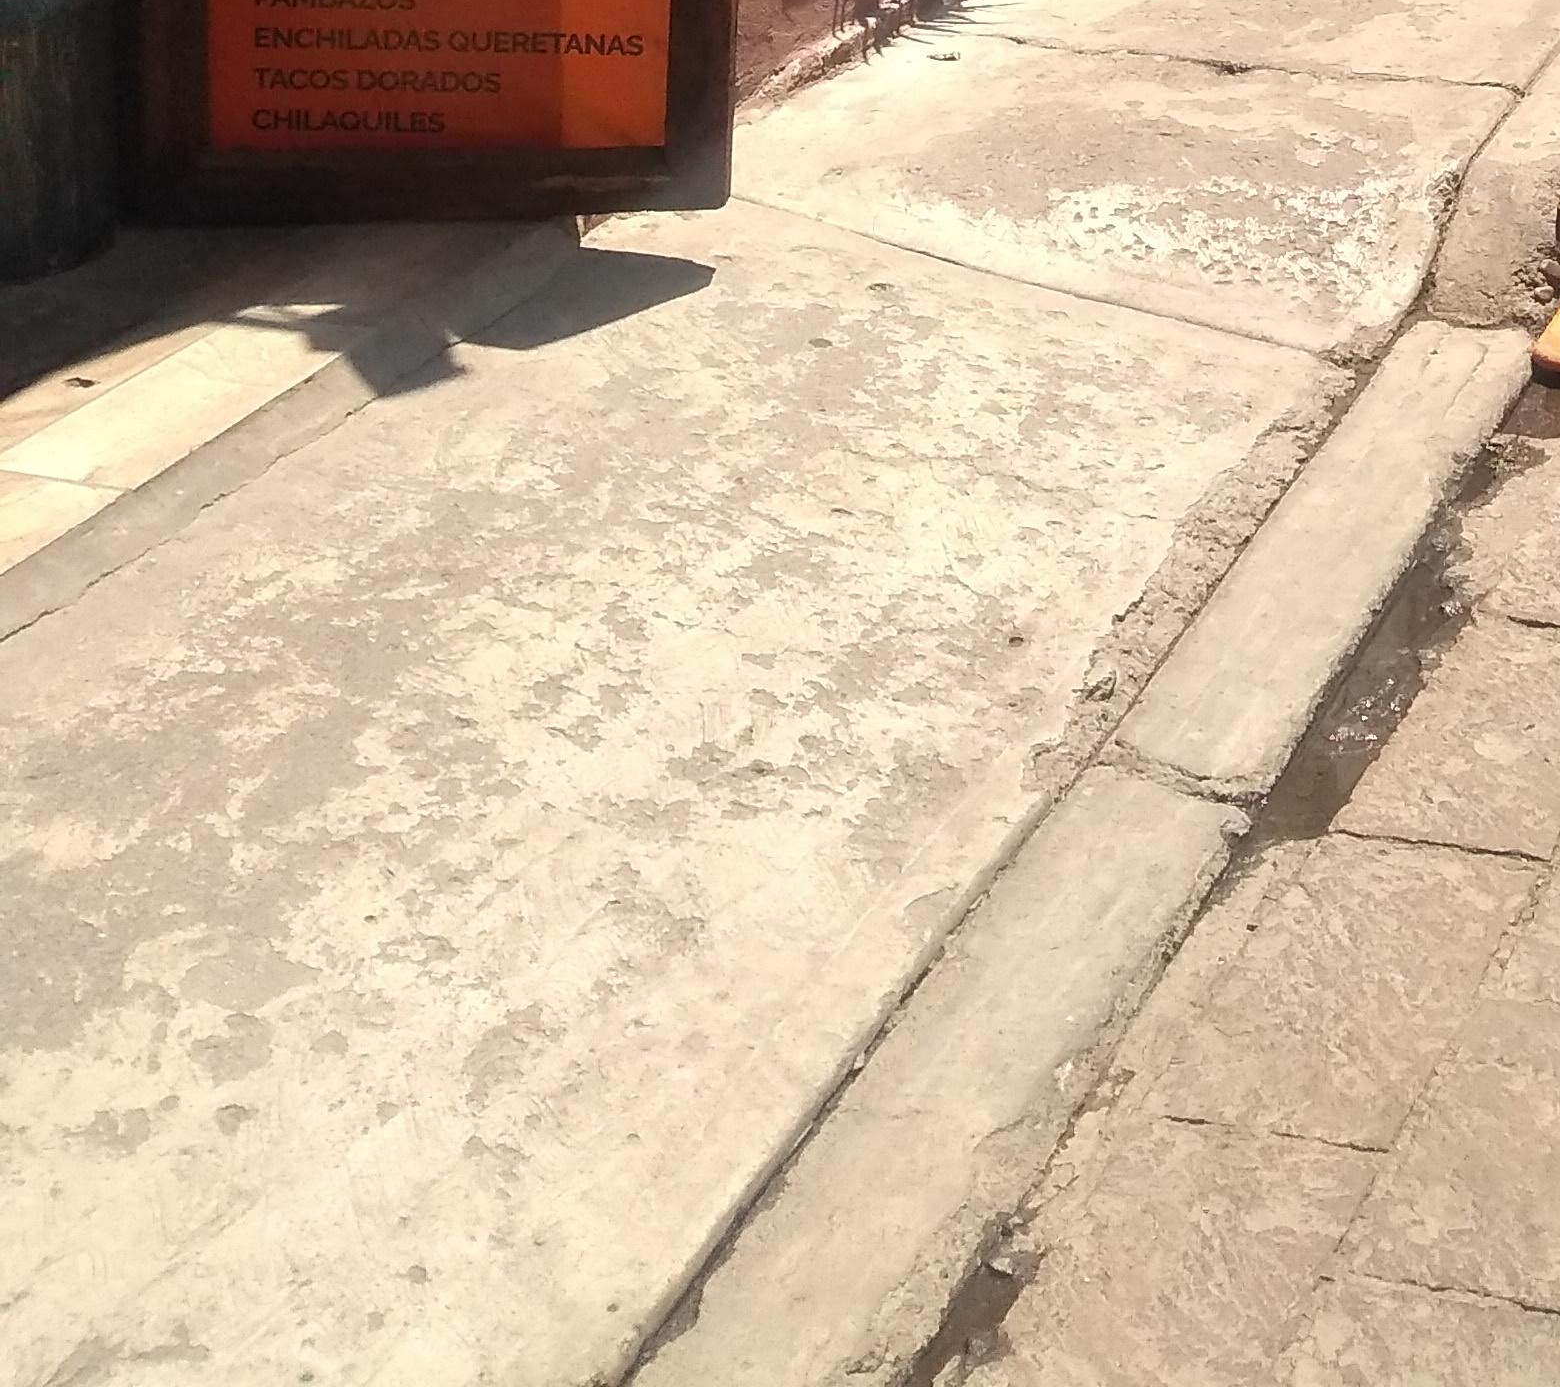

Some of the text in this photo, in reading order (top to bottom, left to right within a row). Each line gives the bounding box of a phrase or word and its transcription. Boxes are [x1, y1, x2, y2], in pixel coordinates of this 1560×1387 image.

[254, 27, 645, 57] ENCHILADAS QUERETANAS
[254, 67, 502, 94] TACOS DORADOS
[252, 108, 446, 134] CHILAQUILES
